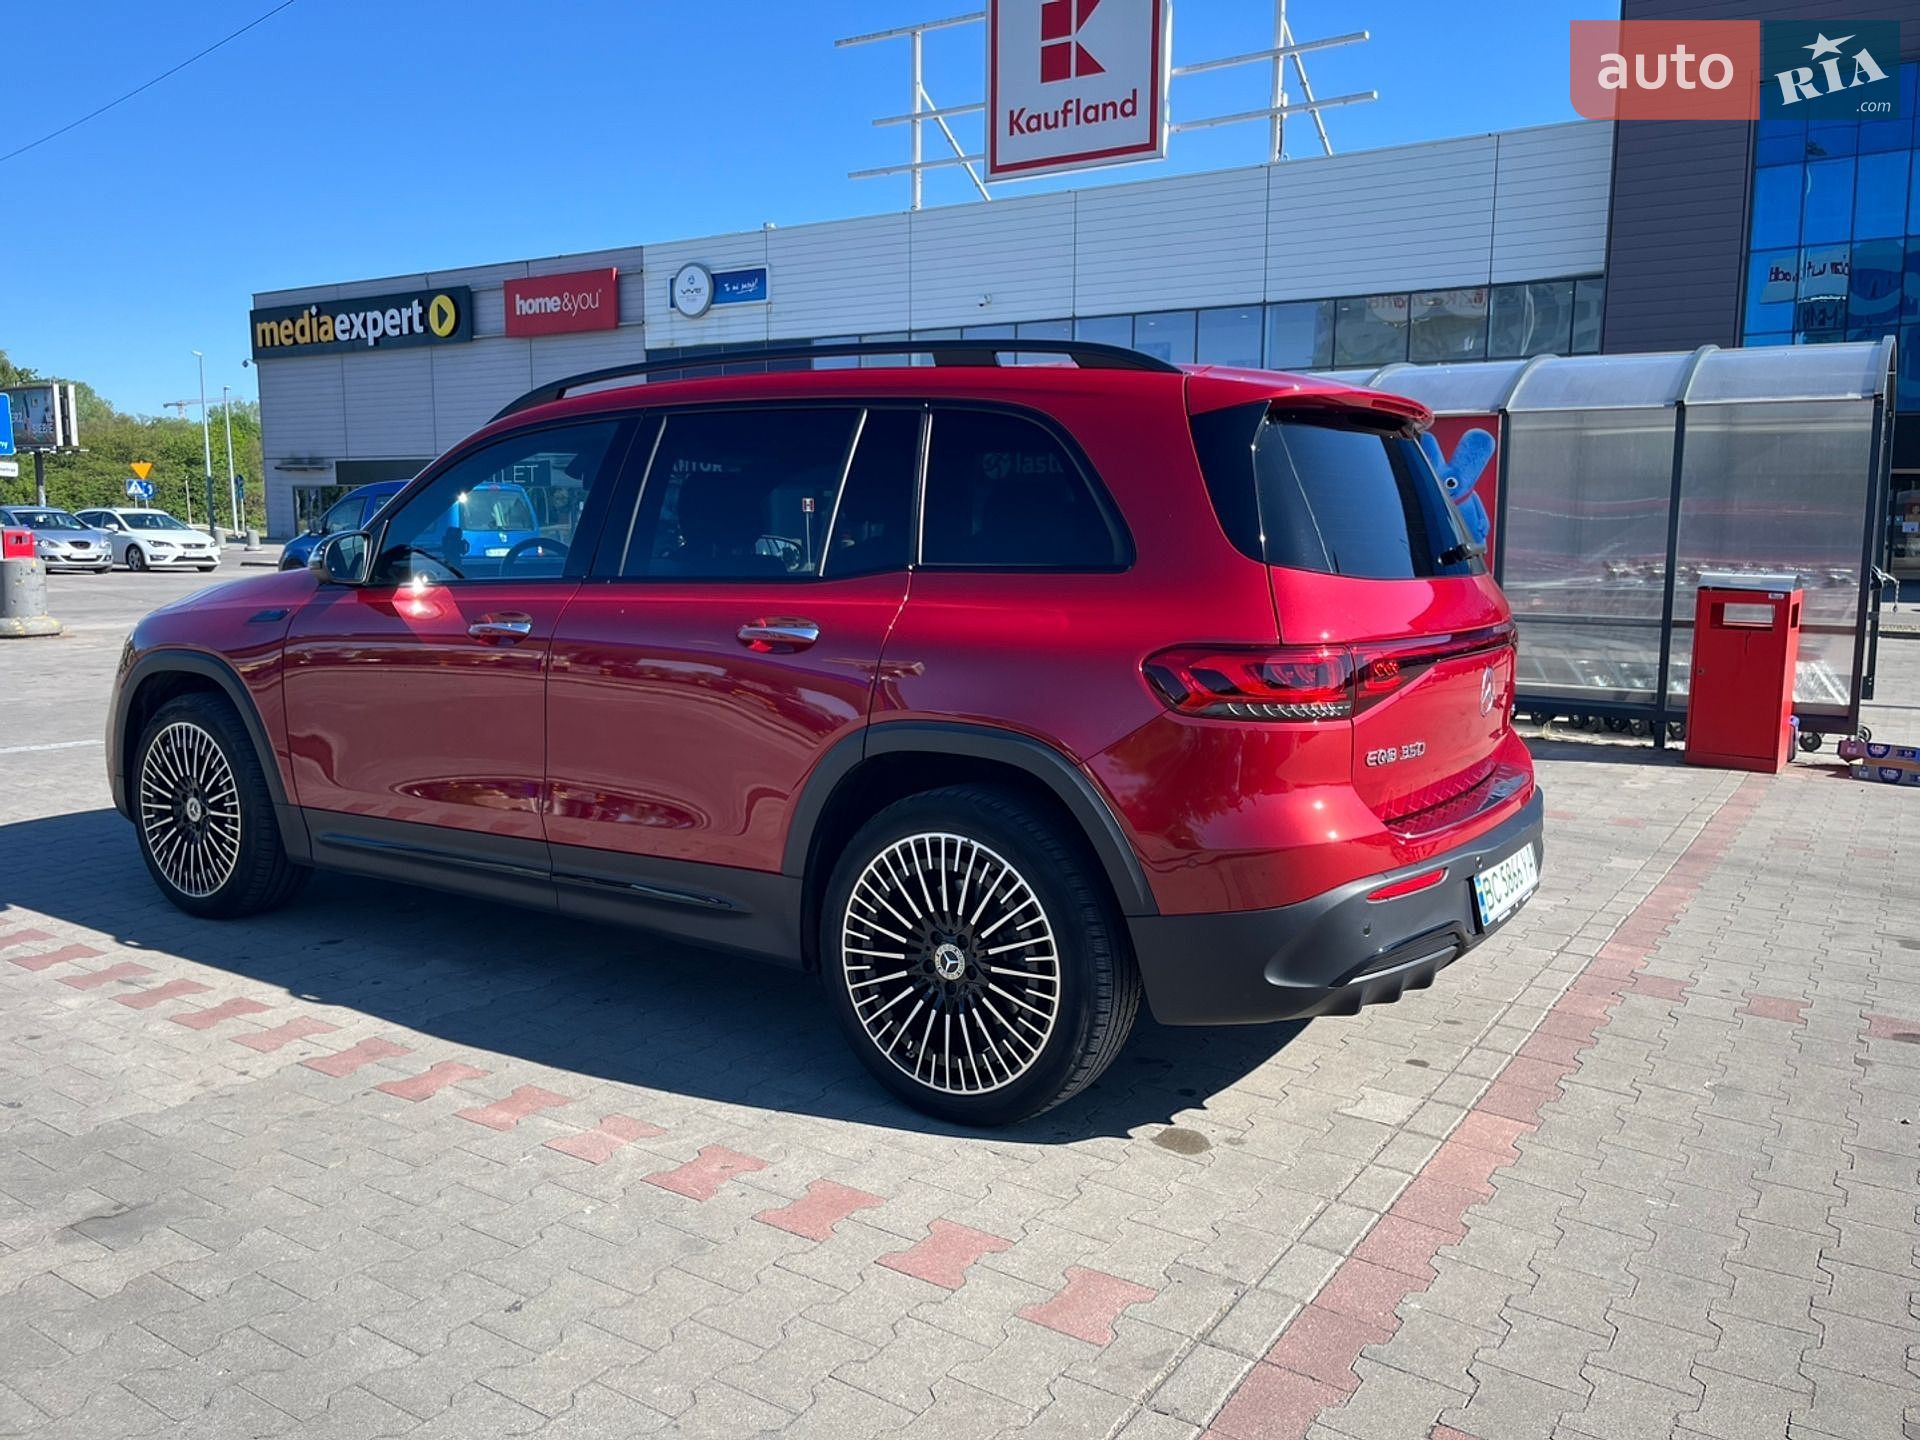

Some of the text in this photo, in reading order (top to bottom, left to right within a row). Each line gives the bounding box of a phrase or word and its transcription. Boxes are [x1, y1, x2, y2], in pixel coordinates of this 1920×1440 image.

[1008, 88, 1138, 136] Kaufland
[256, 298, 424, 348] mediaexpert
[515, 291, 600, 318] home&you
[1366, 742, 1426, 767] EQB 350
